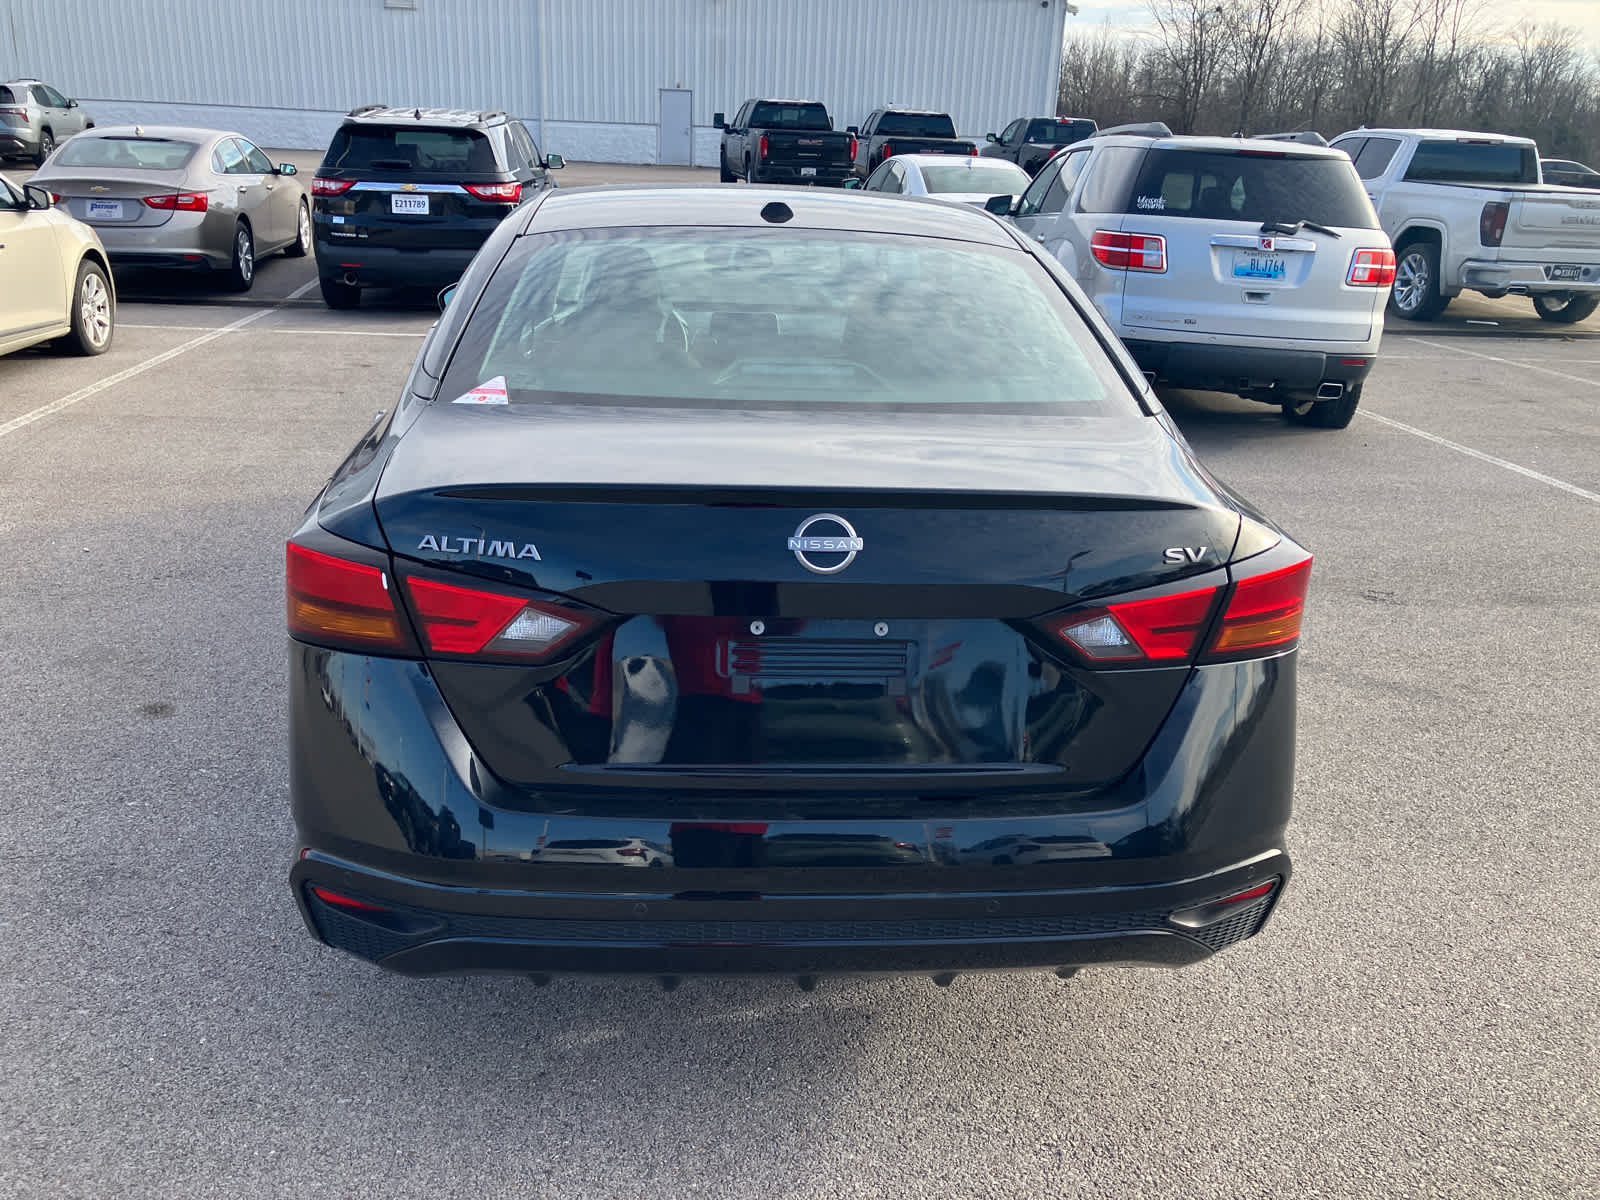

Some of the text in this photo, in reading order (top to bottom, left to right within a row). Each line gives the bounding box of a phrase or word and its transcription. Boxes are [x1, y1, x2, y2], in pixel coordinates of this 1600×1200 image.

[395, 199, 426, 209] E211789
[1250, 258, 1285, 273] BLJ764
[417, 534, 542, 561] ALTIMA
[789, 539, 861, 550] NISSAN
[1162, 546, 1208, 564] SV
